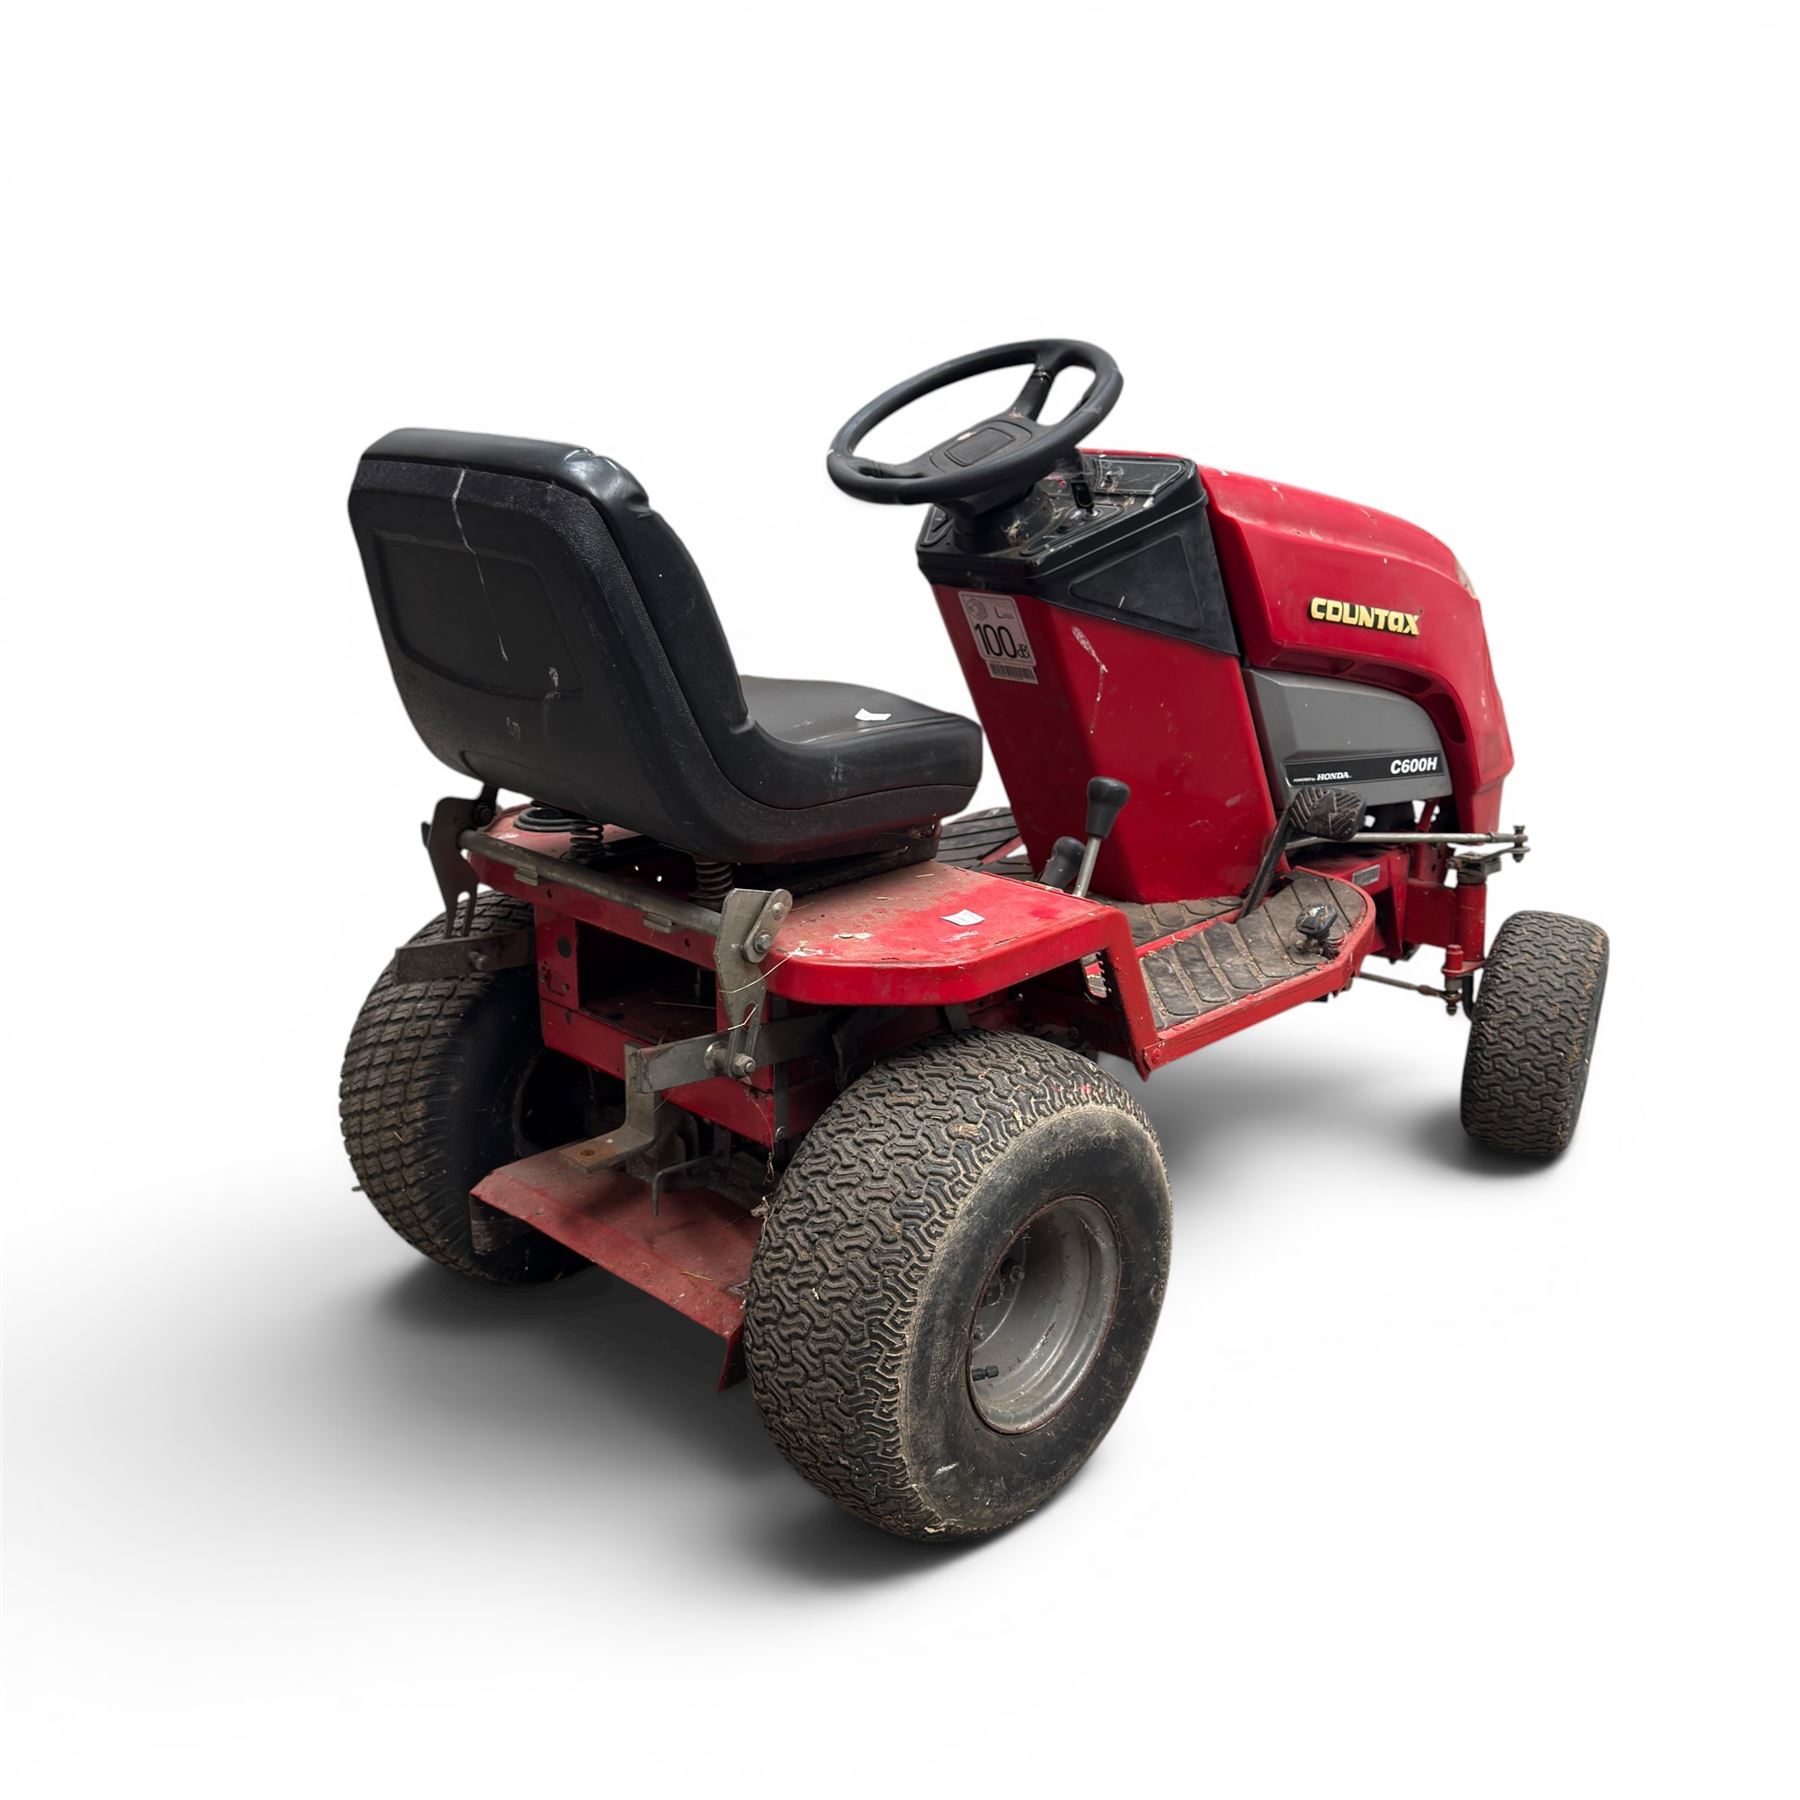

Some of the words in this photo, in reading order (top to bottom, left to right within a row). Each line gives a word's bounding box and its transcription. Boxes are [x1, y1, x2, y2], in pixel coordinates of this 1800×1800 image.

[974, 623, 1017, 658] 100
[1390, 757, 1438, 774] C600H
[1316, 771, 1350, 782] HONDA
